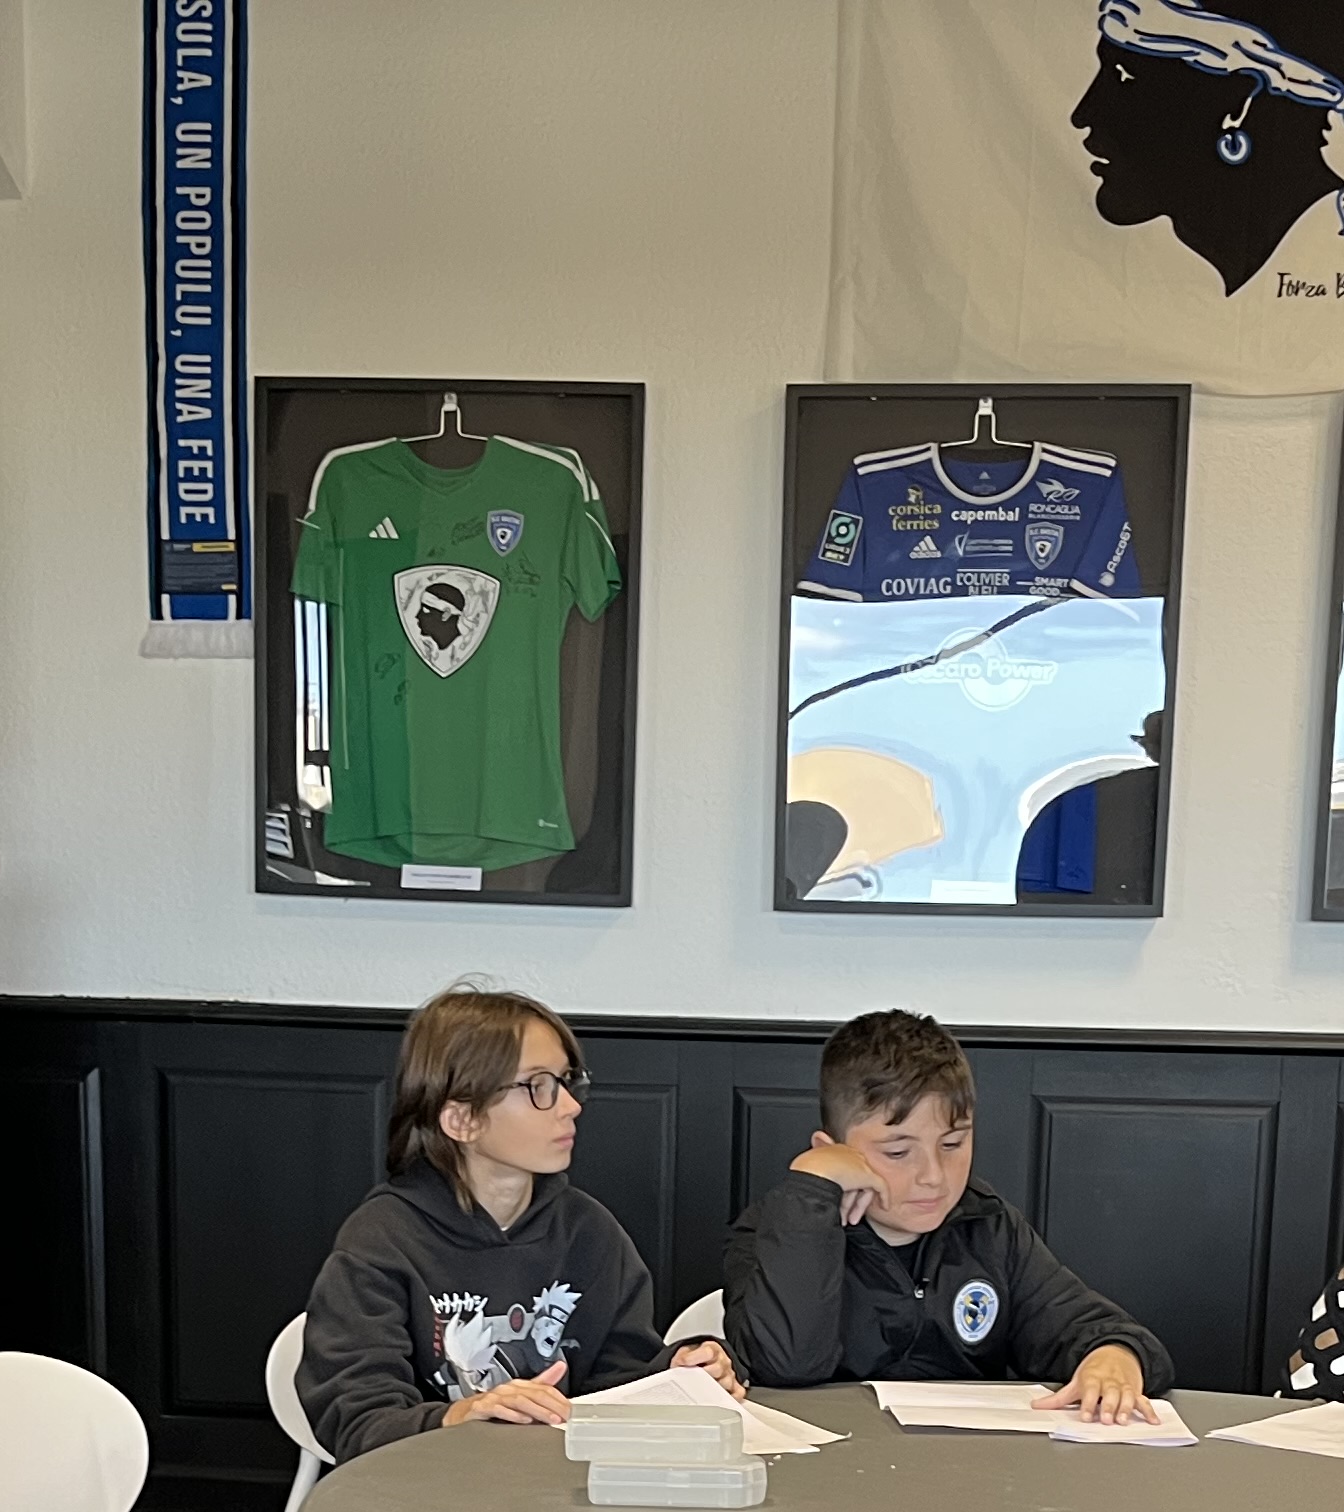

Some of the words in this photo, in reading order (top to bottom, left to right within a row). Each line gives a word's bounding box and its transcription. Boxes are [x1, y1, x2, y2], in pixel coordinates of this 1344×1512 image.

[175, 122, 212, 169] UN
[170, 187, 212, 337] POPULU,
[1277, 272, 1327, 298] Forza
[174, 354, 212, 423] UNA
[177, 438, 216, 524] FEDE
[888, 501, 942, 516] corsica
[951, 506, 1020, 524] capembal
[892, 515, 940, 531] ferries
[881, 577, 952, 596] COVIAG
[1029, 587, 1060, 596] GOOD
[1034, 576, 1069, 587] SMART
[987, 657, 1053, 680] Power
